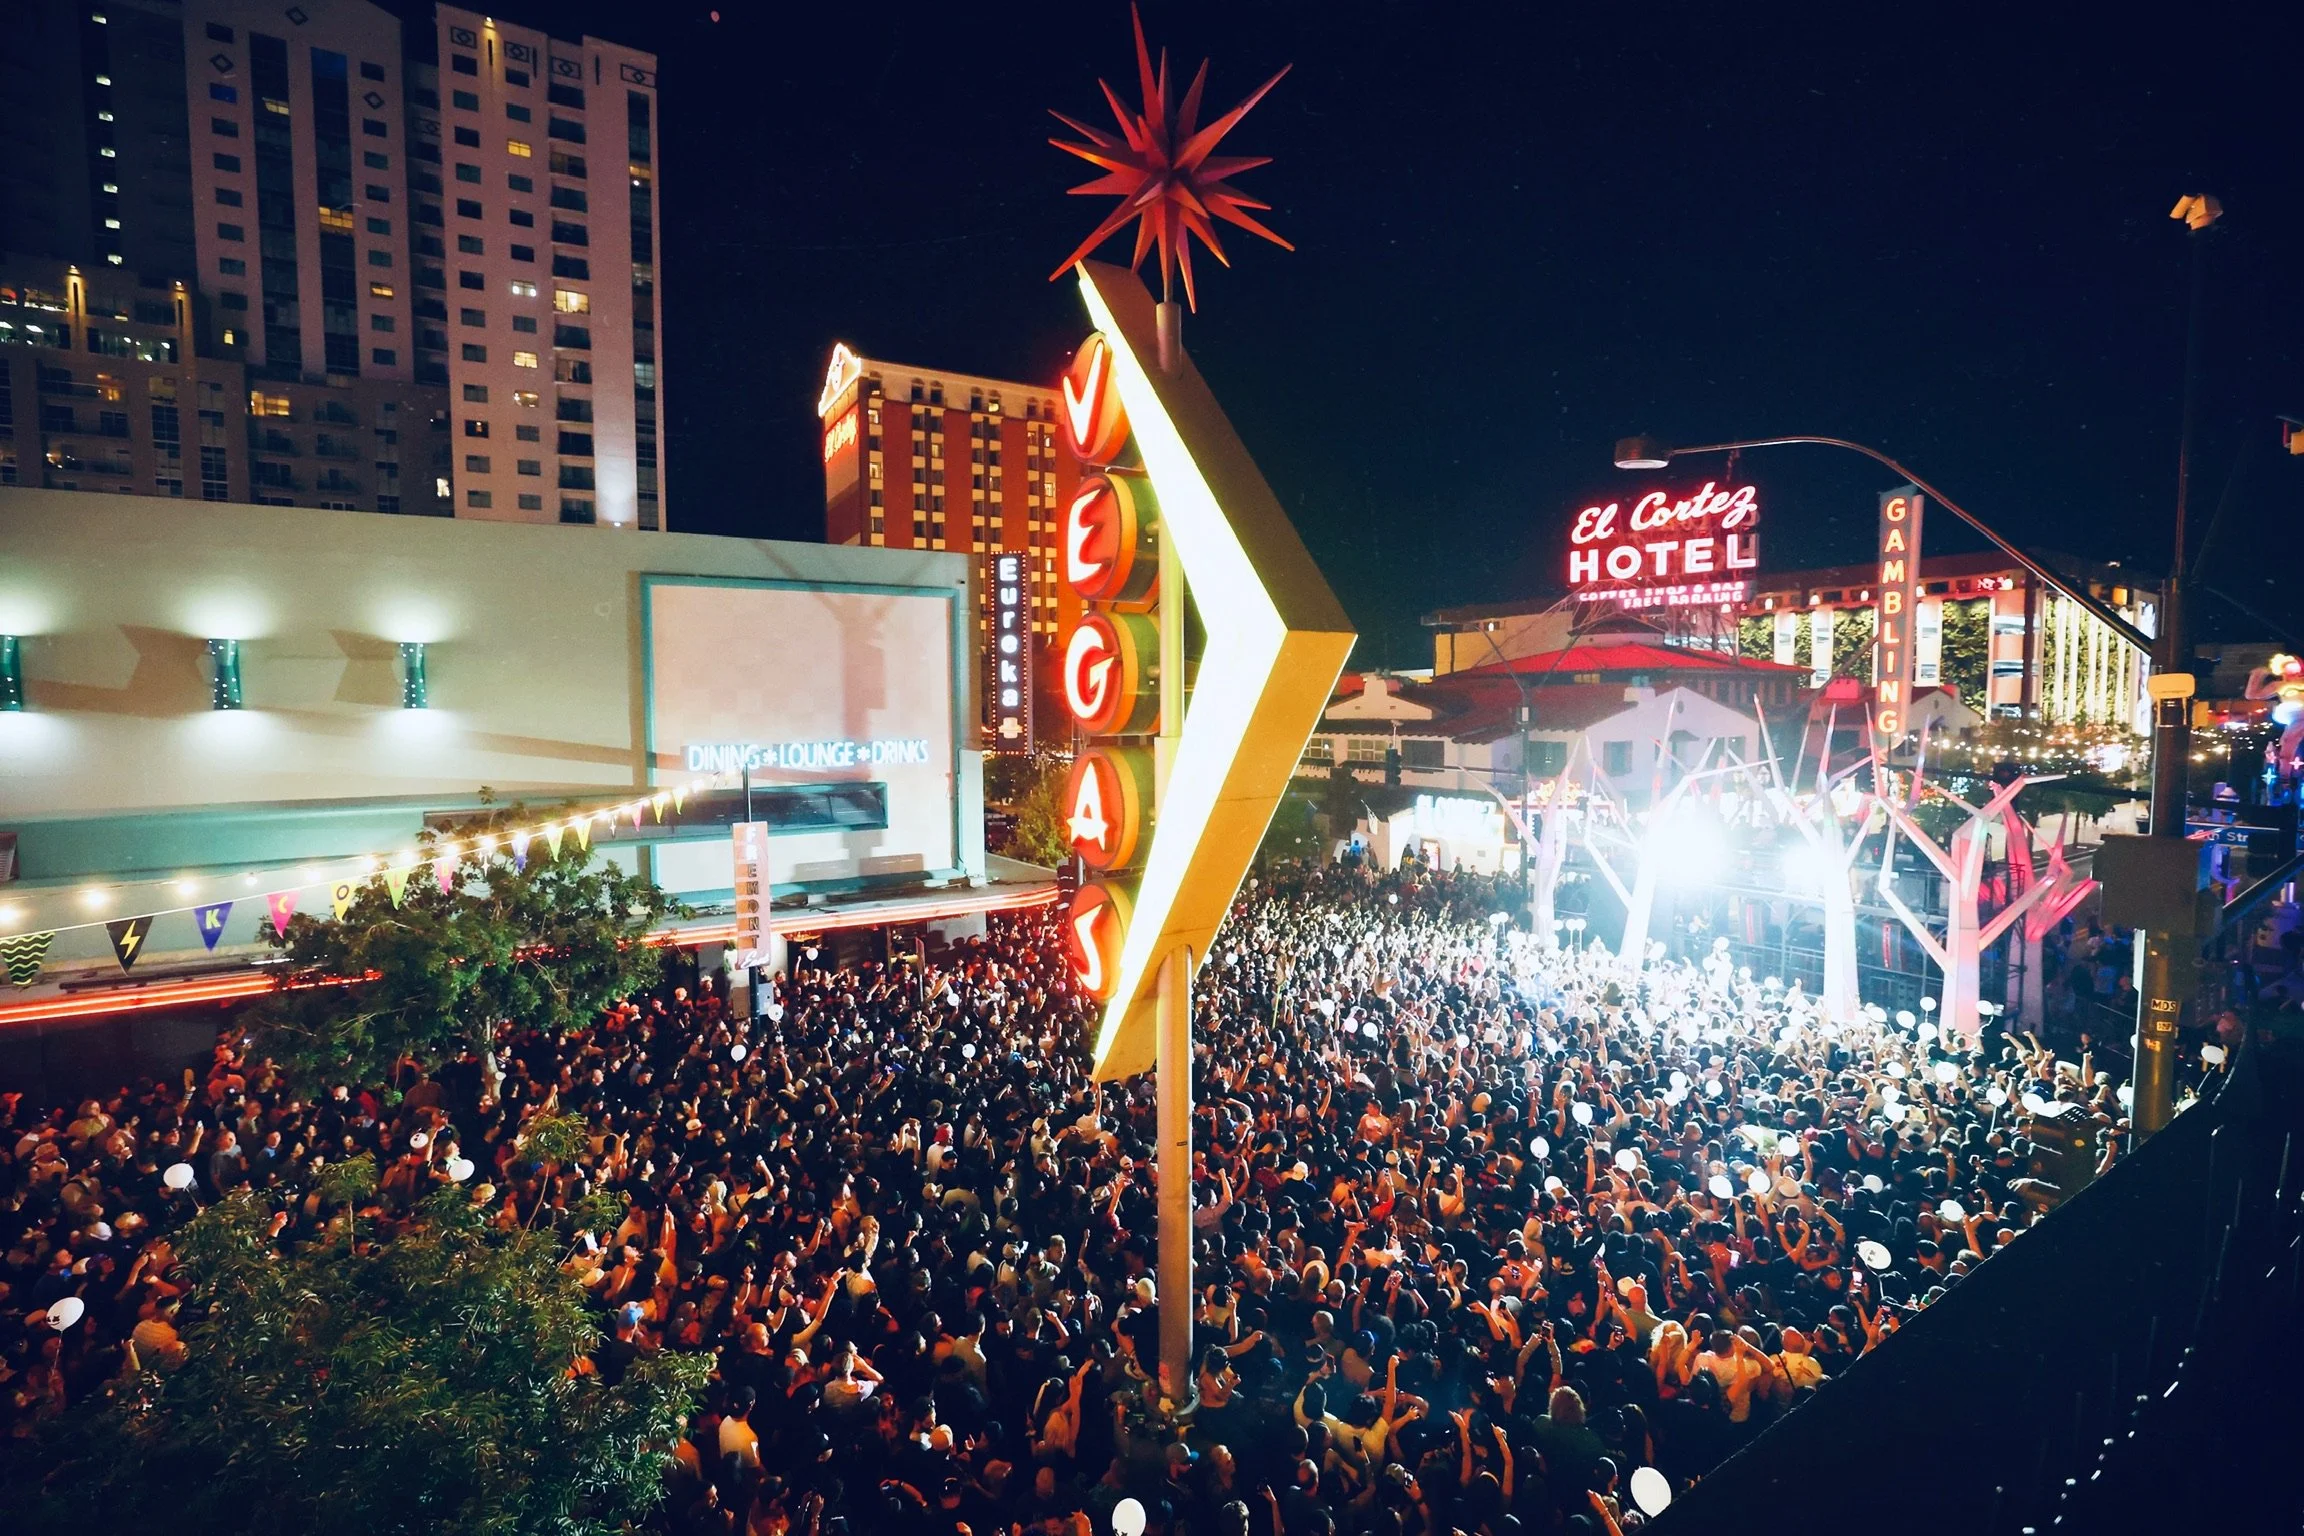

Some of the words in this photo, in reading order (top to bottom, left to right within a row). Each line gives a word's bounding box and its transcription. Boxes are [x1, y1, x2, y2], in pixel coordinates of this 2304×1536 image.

[1571, 503, 1618, 544] El
[1629, 481, 1758, 531] Cortez
[1569, 533, 1757, 583] HOTEL
[1579, 588, 1638, 602] COFFEE
[1645, 585, 1687, 597] SHOP
[1711, 581, 1745, 593] BAR
[1624, 596, 1662, 610] FREE
[1669, 590, 1743, 605] PARKING
[1878, 497, 1906, 733] GAMBLING
[999, 557, 1018, 707] Eureka
[1063, 340, 1114, 992] VEGAS
[688, 744, 761, 771] DINING
[779, 741, 855, 767] LOUNGE
[872, 739, 929, 764] DRINKS
[2227, 832, 2249, 842] Str
[205, 908, 221, 929] K
[336, 884, 350, 900] O
[745, 826, 760, 949] FREMONT
